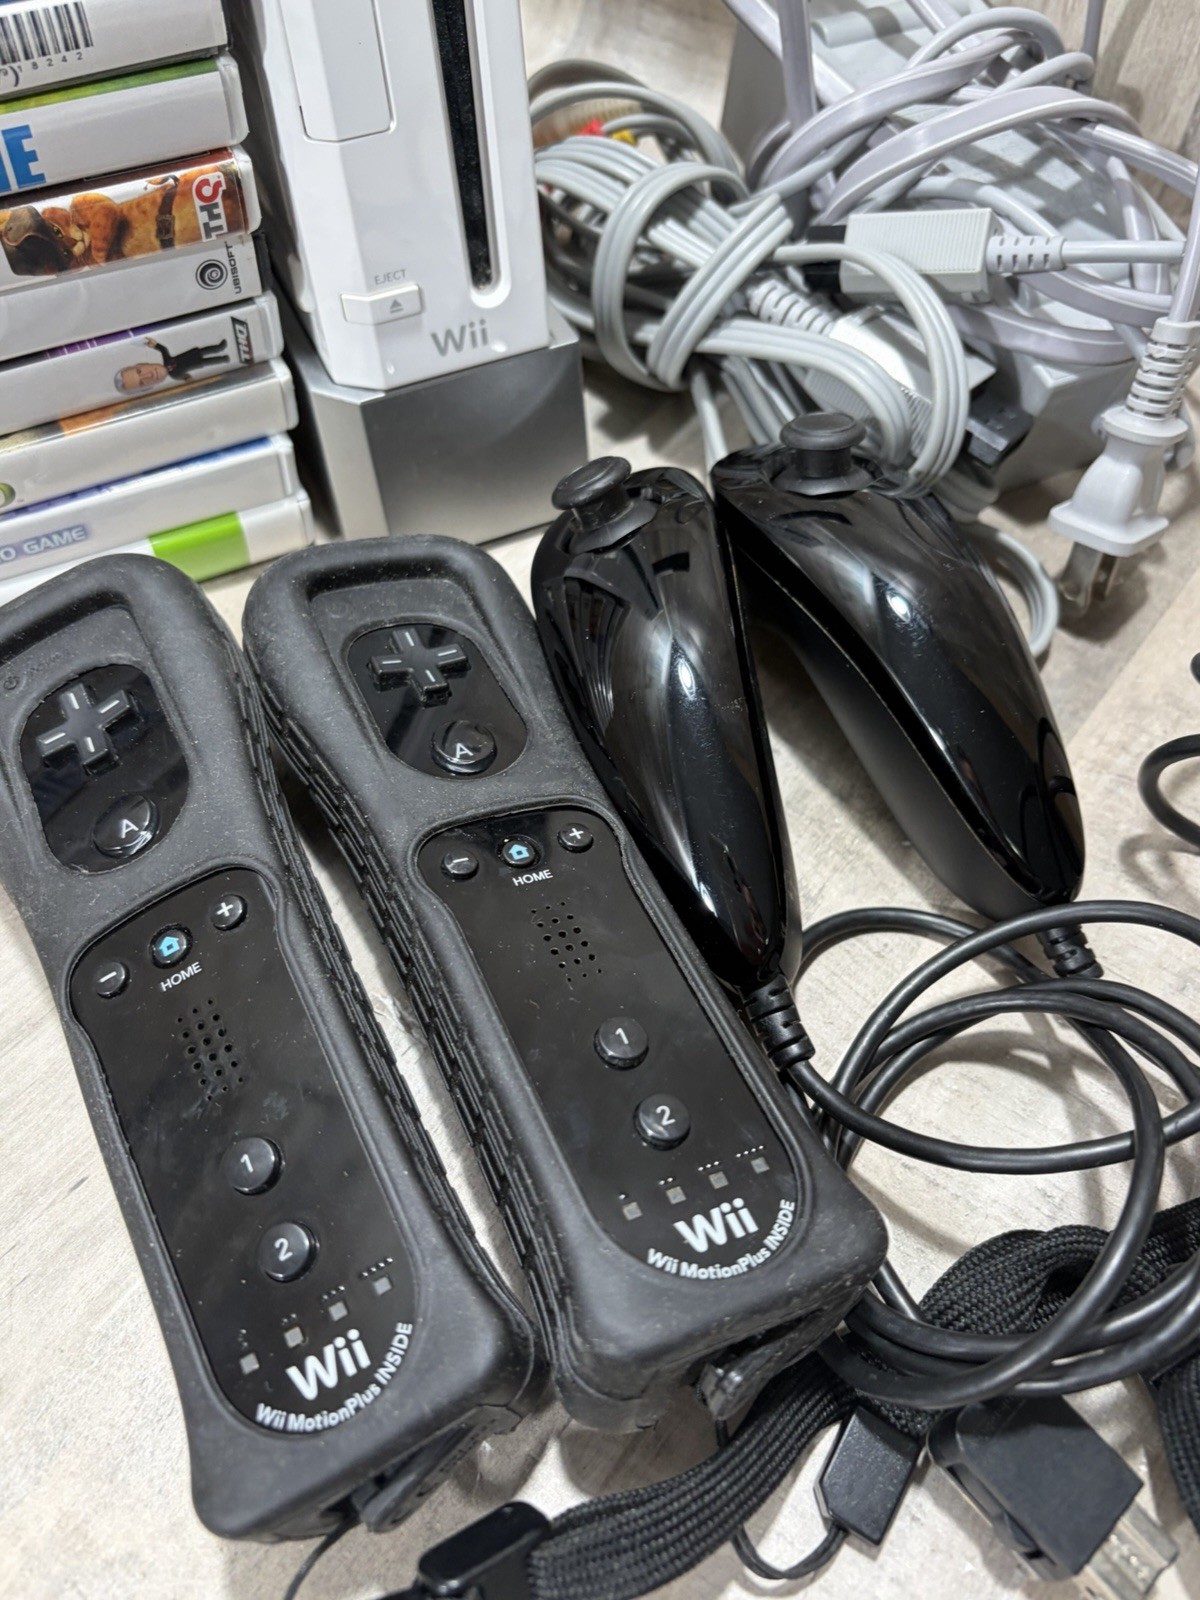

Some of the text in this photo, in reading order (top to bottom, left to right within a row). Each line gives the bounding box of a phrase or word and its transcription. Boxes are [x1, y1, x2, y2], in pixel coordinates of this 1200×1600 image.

[226, 241, 242, 294] UBISOFT
[374, 269, 407, 286] EJECT
[431, 319, 490, 357] Wii
[23, 526, 86, 554] GAME
[455, 742, 474, 760] A
[121, 818, 139, 839] A
[512, 869, 554, 887] HOME
[160, 961, 202, 992] HOME
[615, 1027, 629, 1045] 1
[655, 1105, 676, 1126] 2
[240, 1153, 254, 1173] 1
[673, 1197, 759, 1253] Wii
[274, 1237, 293, 1262] 2
[646, 1199, 796, 1280] Wii MotionPlus INSIDE
[256, 1321, 413, 1433] Wii MotionPlus INSIDE
[285, 1328, 371, 1400] Wii
